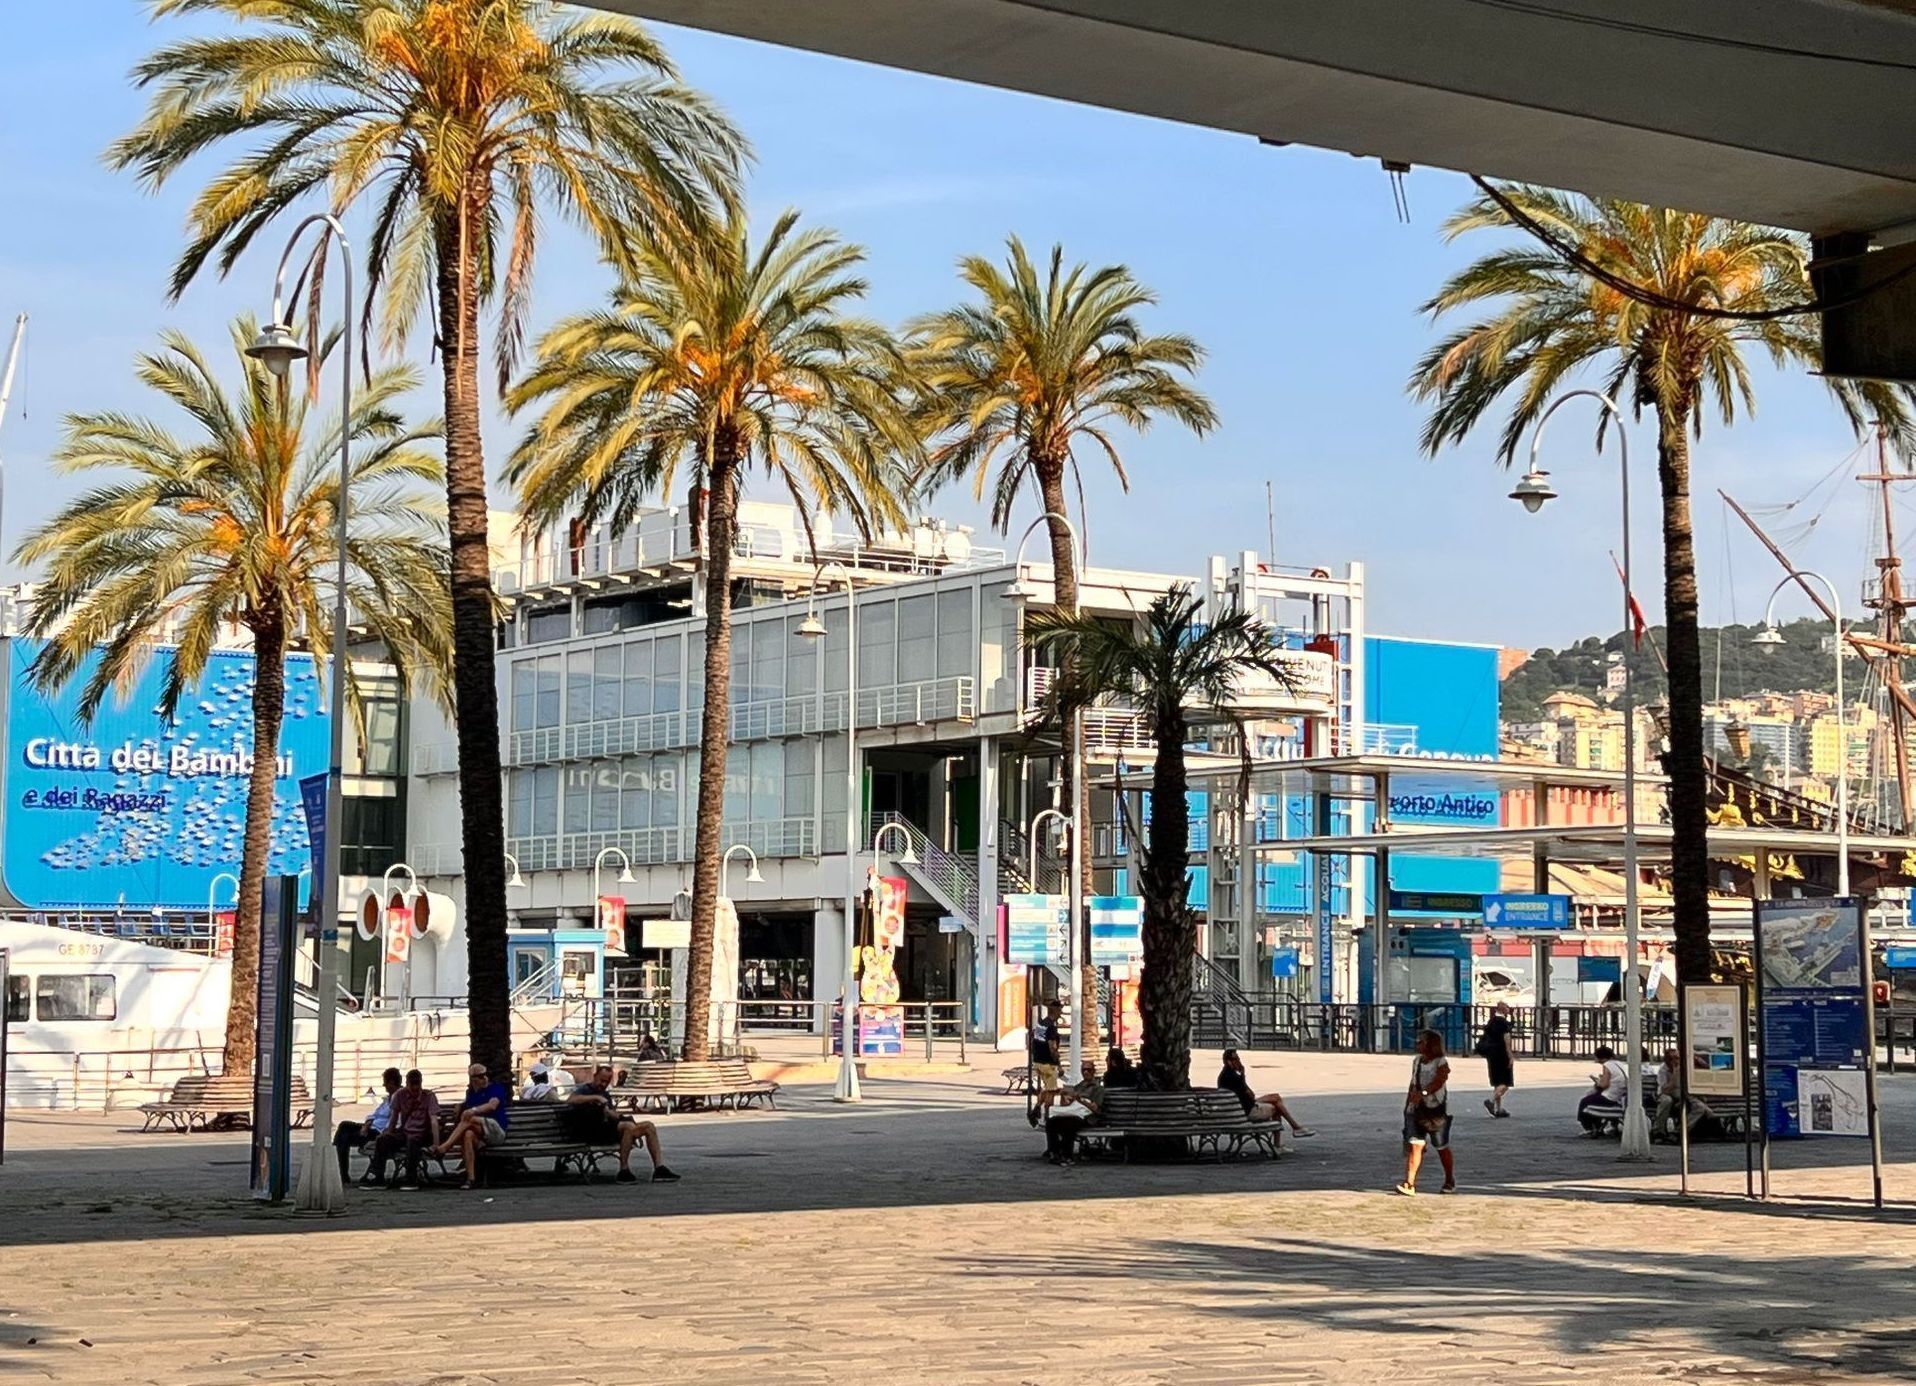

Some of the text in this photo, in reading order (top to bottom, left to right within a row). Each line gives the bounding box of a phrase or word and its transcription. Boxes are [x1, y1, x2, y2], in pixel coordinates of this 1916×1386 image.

[112, 741, 159, 770] dei
[171, 744, 293, 776] Bambni
[23, 785, 166, 811] e dei Ragazzi
[1441, 794, 1495, 815] Antico
[1321, 909, 1330, 976] ENTRANCE
